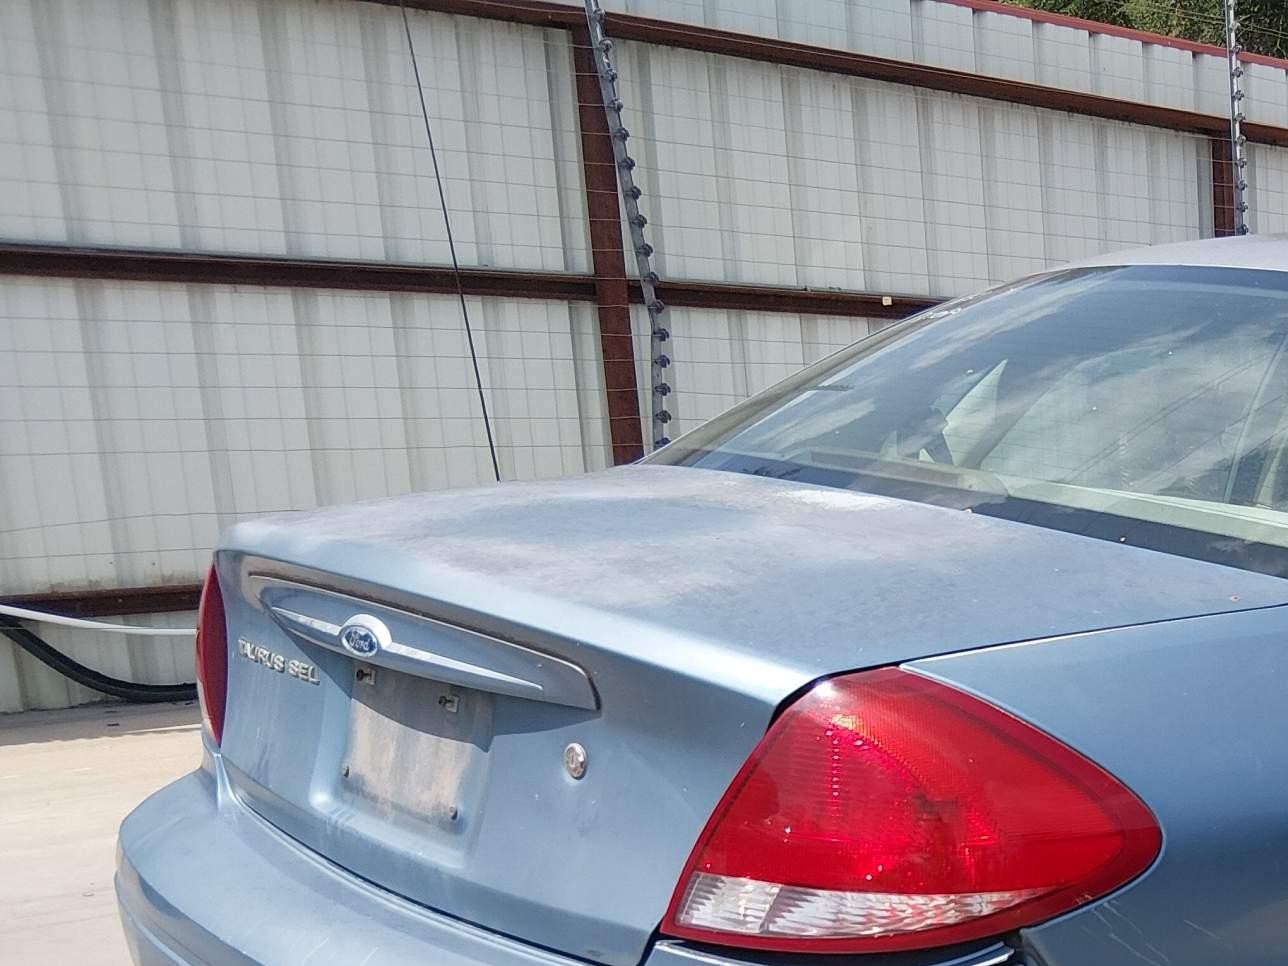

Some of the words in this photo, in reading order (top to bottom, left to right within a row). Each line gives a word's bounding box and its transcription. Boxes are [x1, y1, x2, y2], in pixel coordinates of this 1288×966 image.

[348, 630, 372, 652] Ford
[238, 638, 285, 674] TAURUS
[288, 658, 321, 686] SEL
